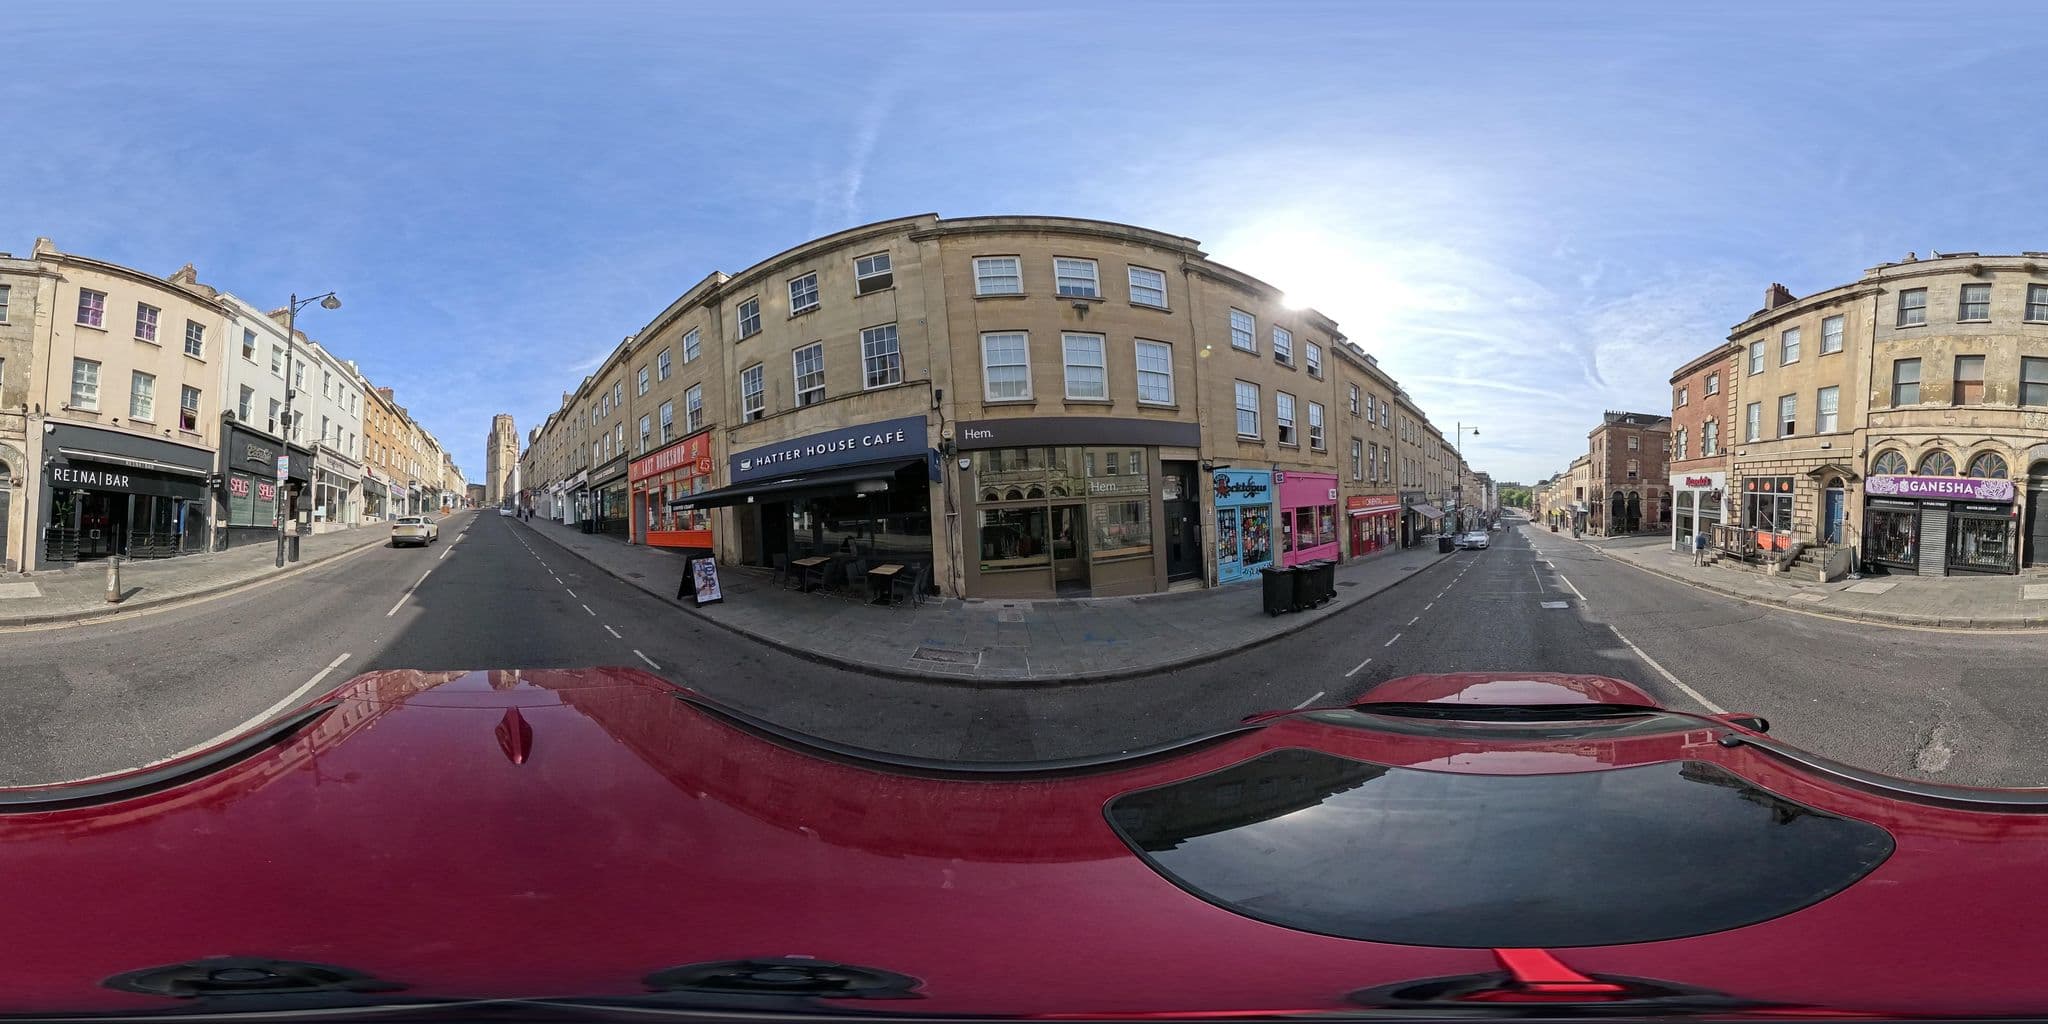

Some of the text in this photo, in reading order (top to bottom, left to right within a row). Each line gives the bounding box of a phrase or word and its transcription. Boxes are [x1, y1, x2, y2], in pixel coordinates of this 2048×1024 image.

[964, 428, 994, 440] Hem.
[756, 428, 905, 467] HATTER HOUSE CAFÉ
[231, 478, 249, 493] SALE
[259, 483, 275, 497] SALE
[1089, 481, 1119, 492] Hem.
[1910, 481, 1974, 494] GANESHA
